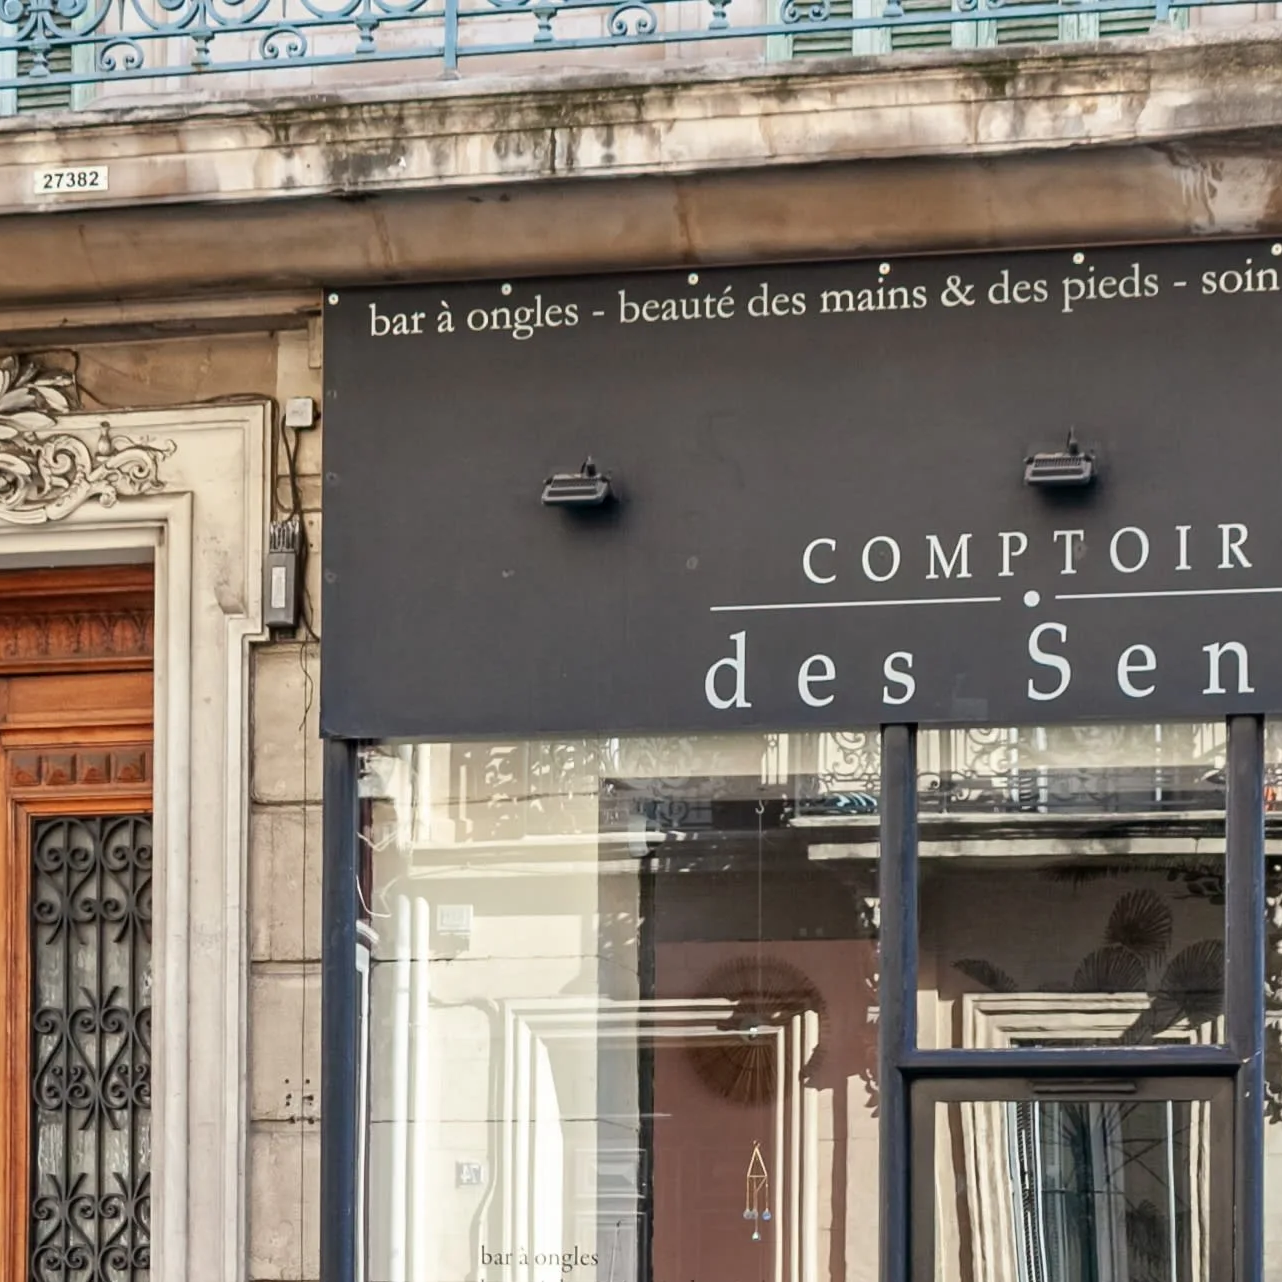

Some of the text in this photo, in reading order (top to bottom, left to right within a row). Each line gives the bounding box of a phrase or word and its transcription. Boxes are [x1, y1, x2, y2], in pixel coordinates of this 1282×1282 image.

[43, 171, 99, 189] 27382
[369, 303, 426, 337] bar
[437, 299, 455, 334] à
[467, 295, 579, 340] ongles
[618, 283, 735, 323] beauté
[747, 282, 806, 317] des
[820, 276, 927, 313] mains
[940, 275, 975, 307] &
[988, 269, 1048, 305] des
[1062, 263, 1159, 313] pieds
[1202, 258, 1280, 294] soin
[802, 523, 1254, 584] COMPTOIR
[704, 630, 916, 710] des
[480, 1246, 599, 1273] bar à ongles
